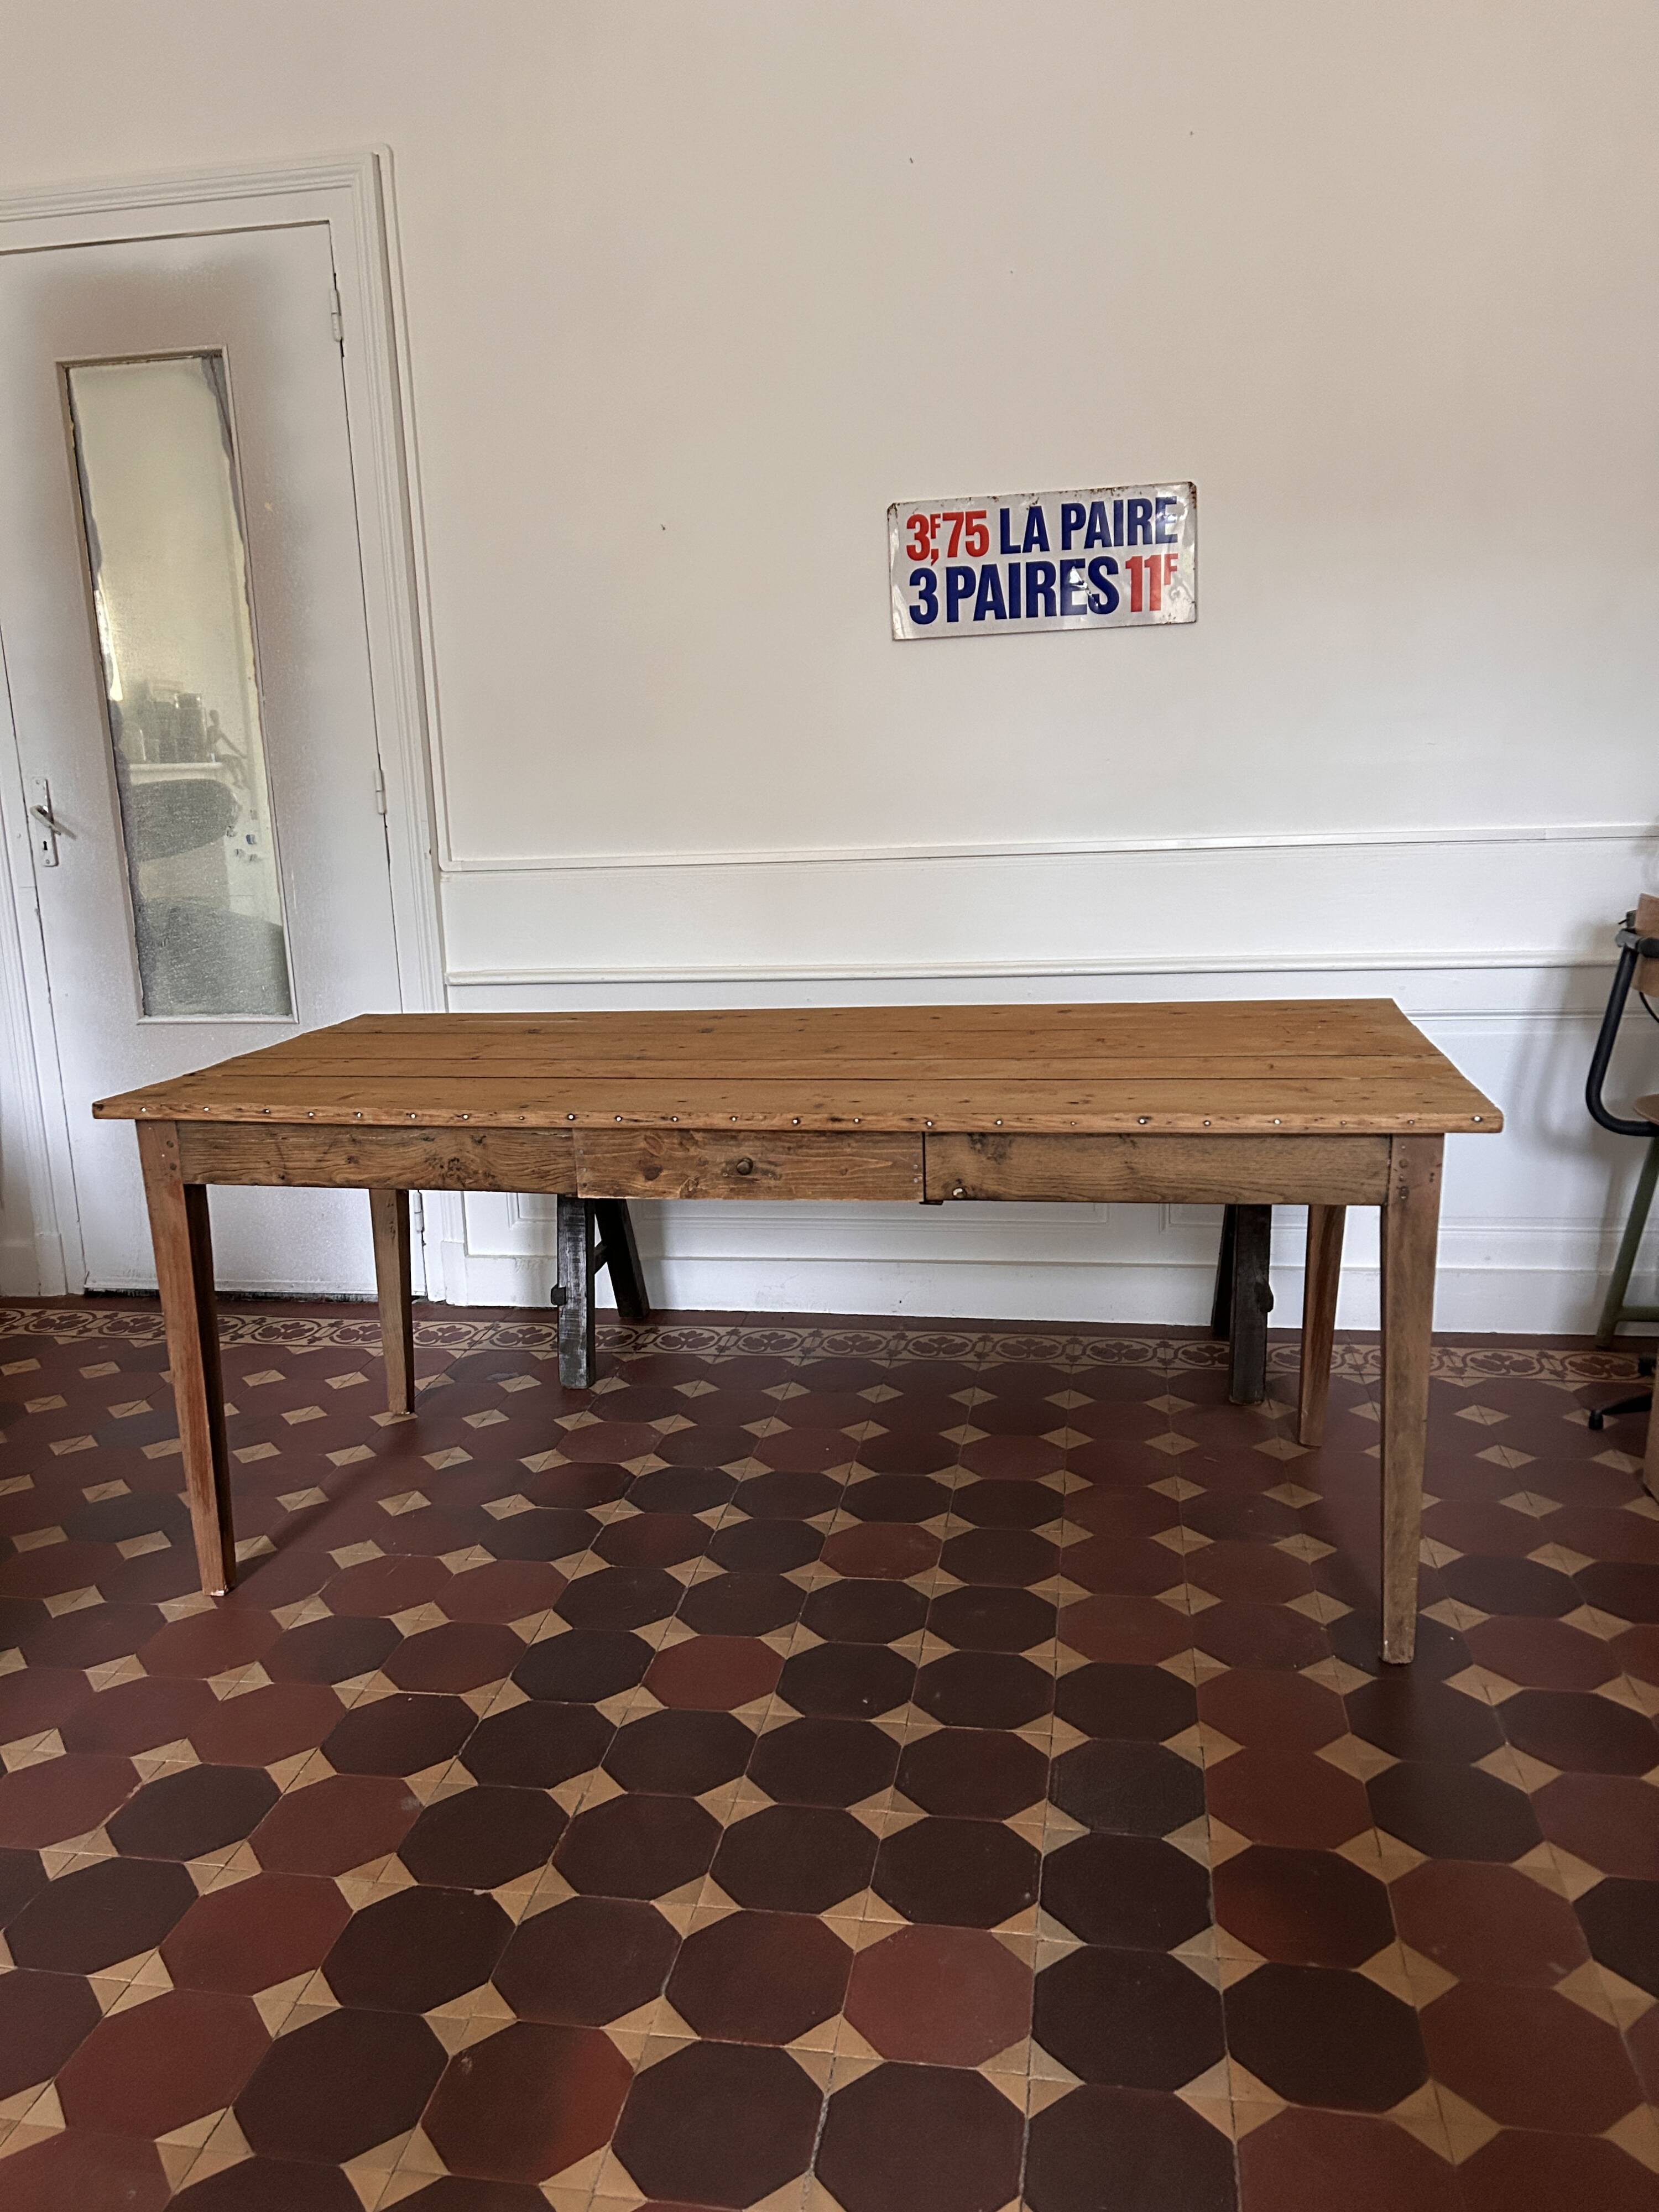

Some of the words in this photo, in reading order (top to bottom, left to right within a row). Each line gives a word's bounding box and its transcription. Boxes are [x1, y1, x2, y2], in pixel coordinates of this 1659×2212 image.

[999, 505, 1050, 555] LA
[1061, 496, 1178, 551] PAIRE
[909, 567, 938, 625] 3
[946, 556, 1120, 623] PAIRES
[1125, 553, 1178, 612] 11F
